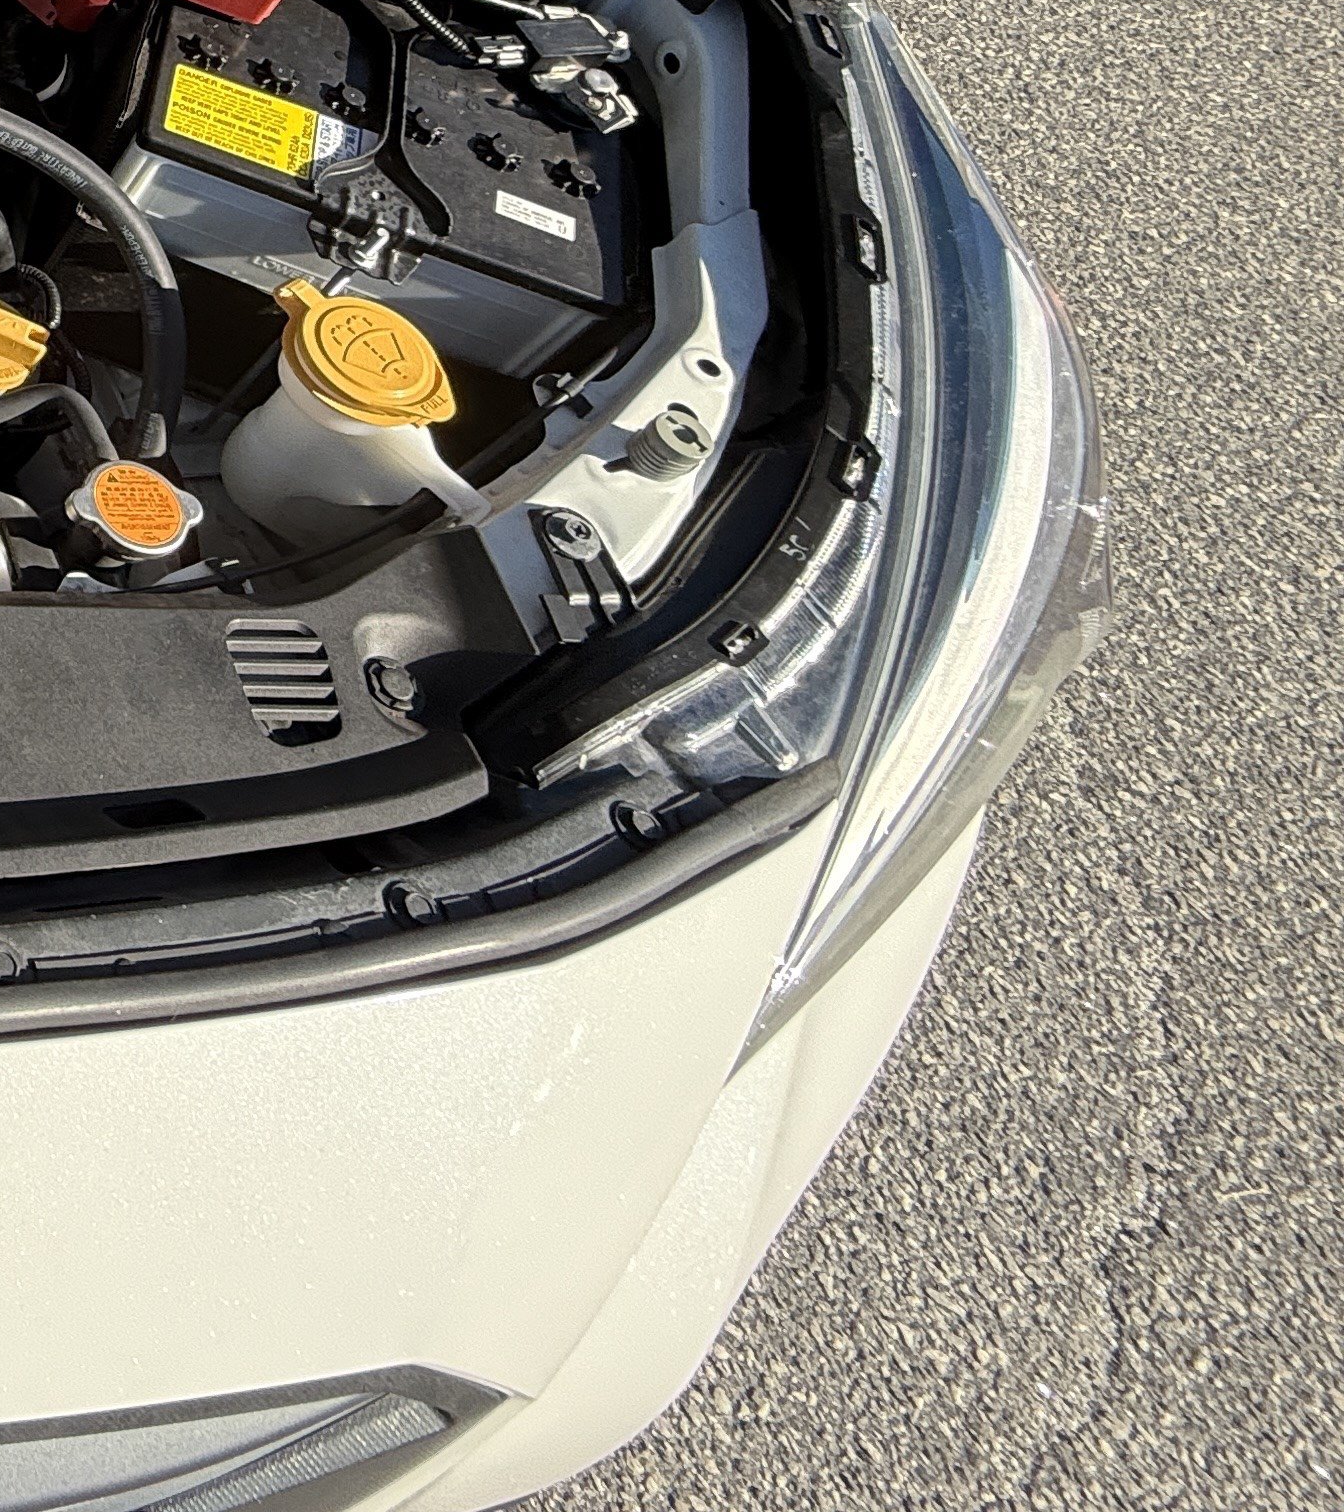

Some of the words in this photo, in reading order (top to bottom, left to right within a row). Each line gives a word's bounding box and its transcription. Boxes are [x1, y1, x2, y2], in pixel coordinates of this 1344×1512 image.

[178, 68, 218, 87] DANGER
[172, 101, 211, 121] POISON
[420, 395, 449, 414] FULL
